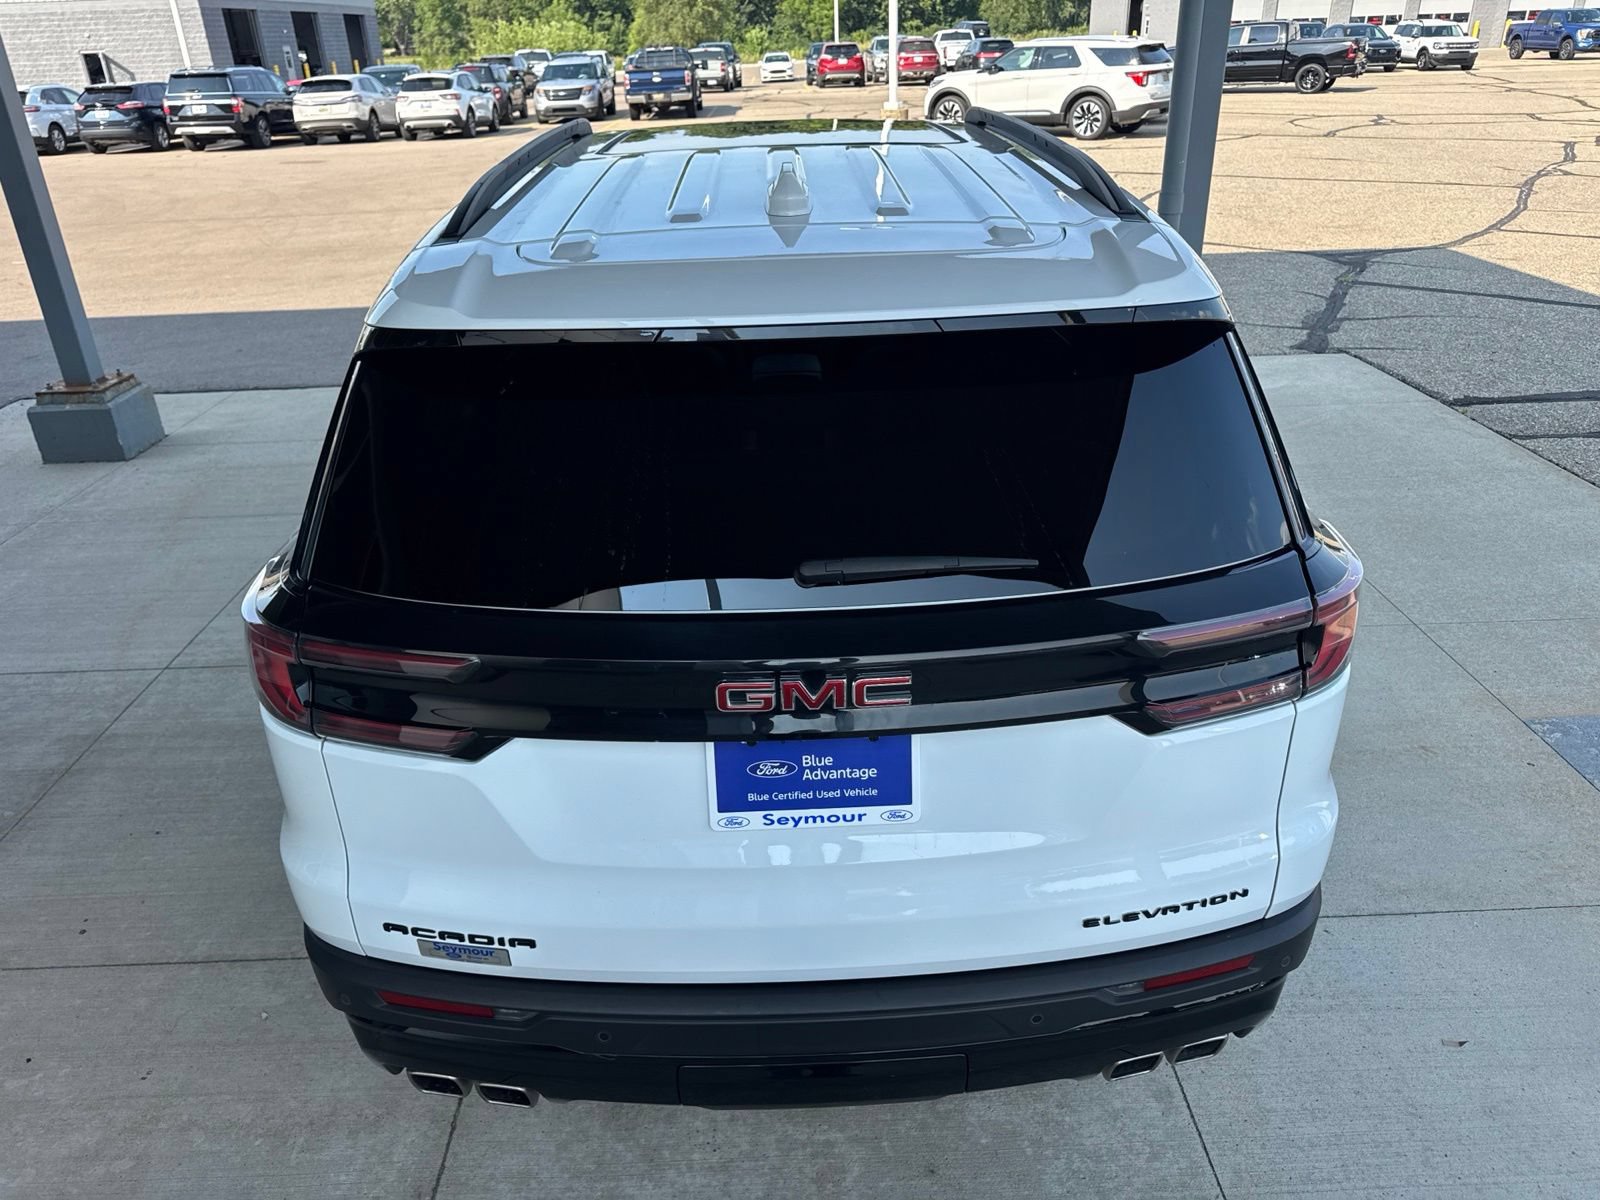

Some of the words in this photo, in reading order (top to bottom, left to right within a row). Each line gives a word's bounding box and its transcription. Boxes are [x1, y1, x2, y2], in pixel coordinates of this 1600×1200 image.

[715, 674, 912, 712] GMC
[802, 755, 833, 767] Blue
[802, 767, 878, 781] Advantage
[748, 792, 769, 802] Blue
[772, 790, 813, 801] Certified
[816, 789, 840, 799] Used
[844, 787, 878, 797] Vehicle
[762, 811, 867, 828] Seymour
[1081, 888, 1249, 929] ELEVATION
[383, 922, 537, 949] ACADIA
[432, 941, 495, 957] Seymour
